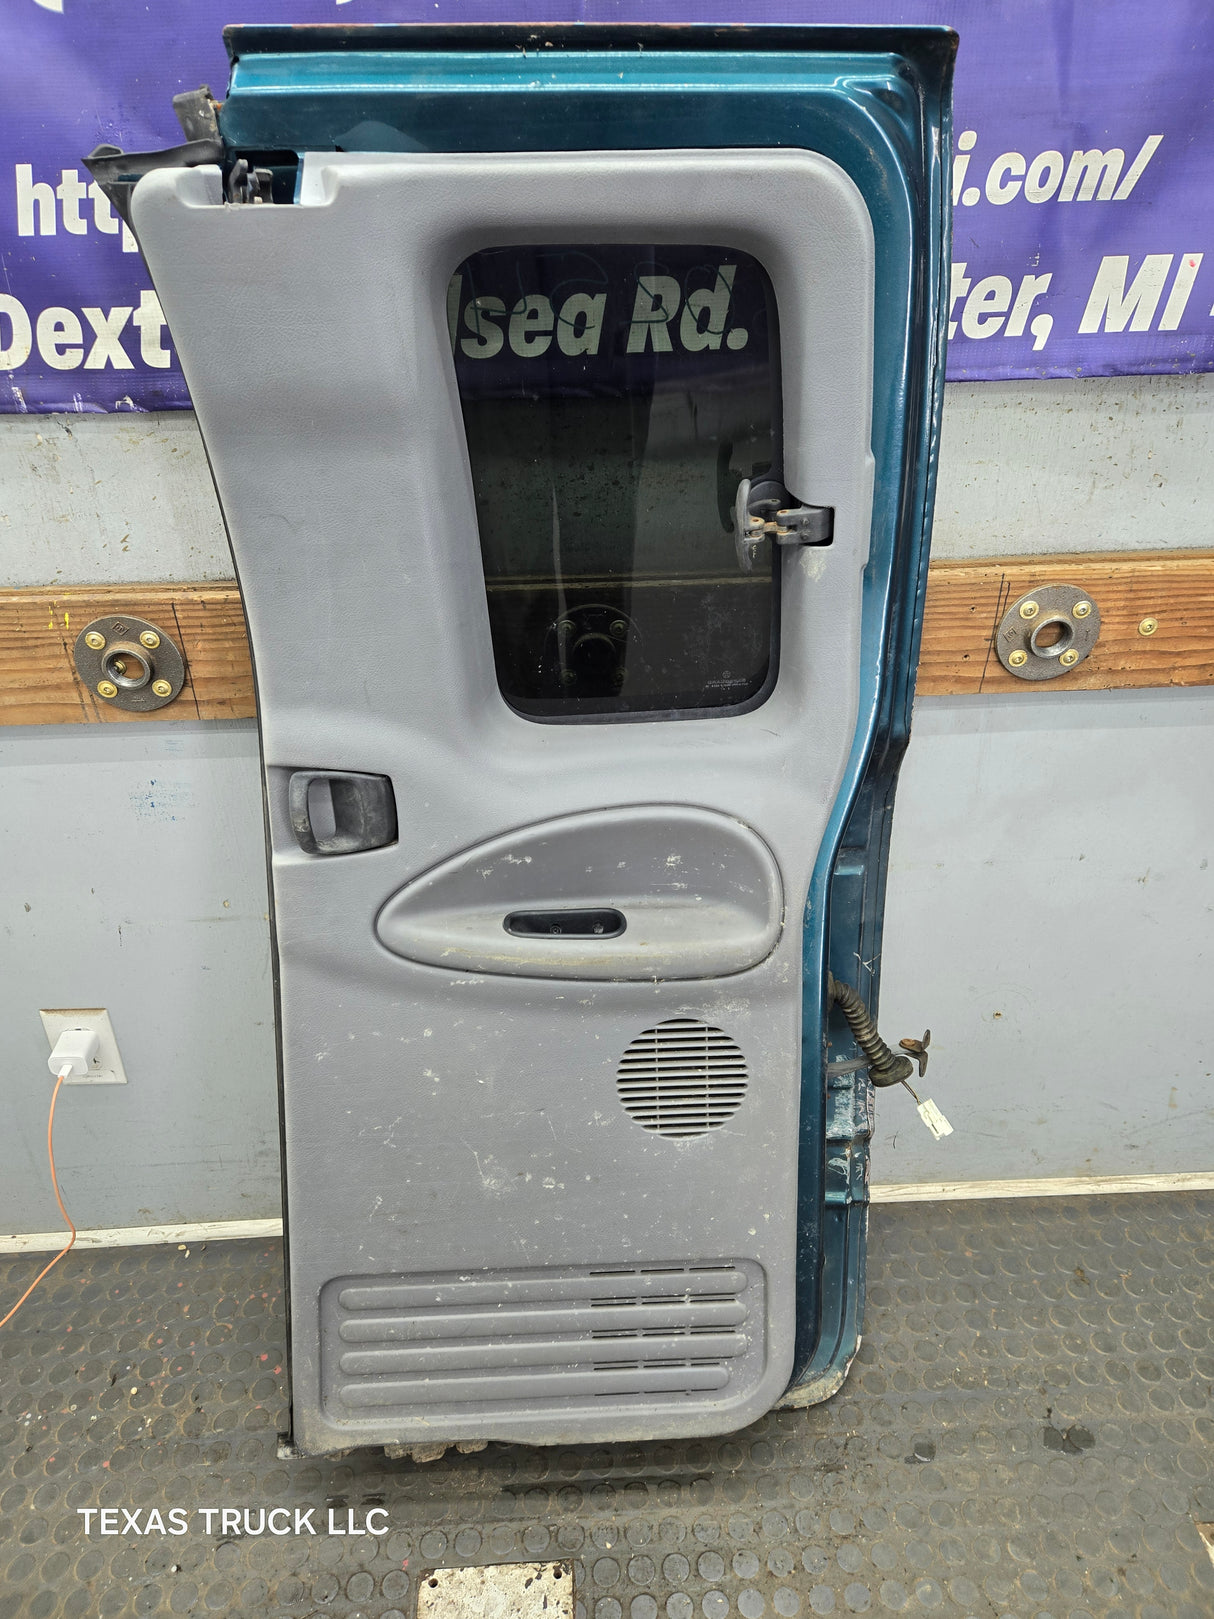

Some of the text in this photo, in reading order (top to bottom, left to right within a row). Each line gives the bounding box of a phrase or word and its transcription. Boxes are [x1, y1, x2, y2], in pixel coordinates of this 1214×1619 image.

[0, 289, 171, 370] Dext
[626, 264, 749, 354] Rd.
[1077, 252, 1205, 334] MI
